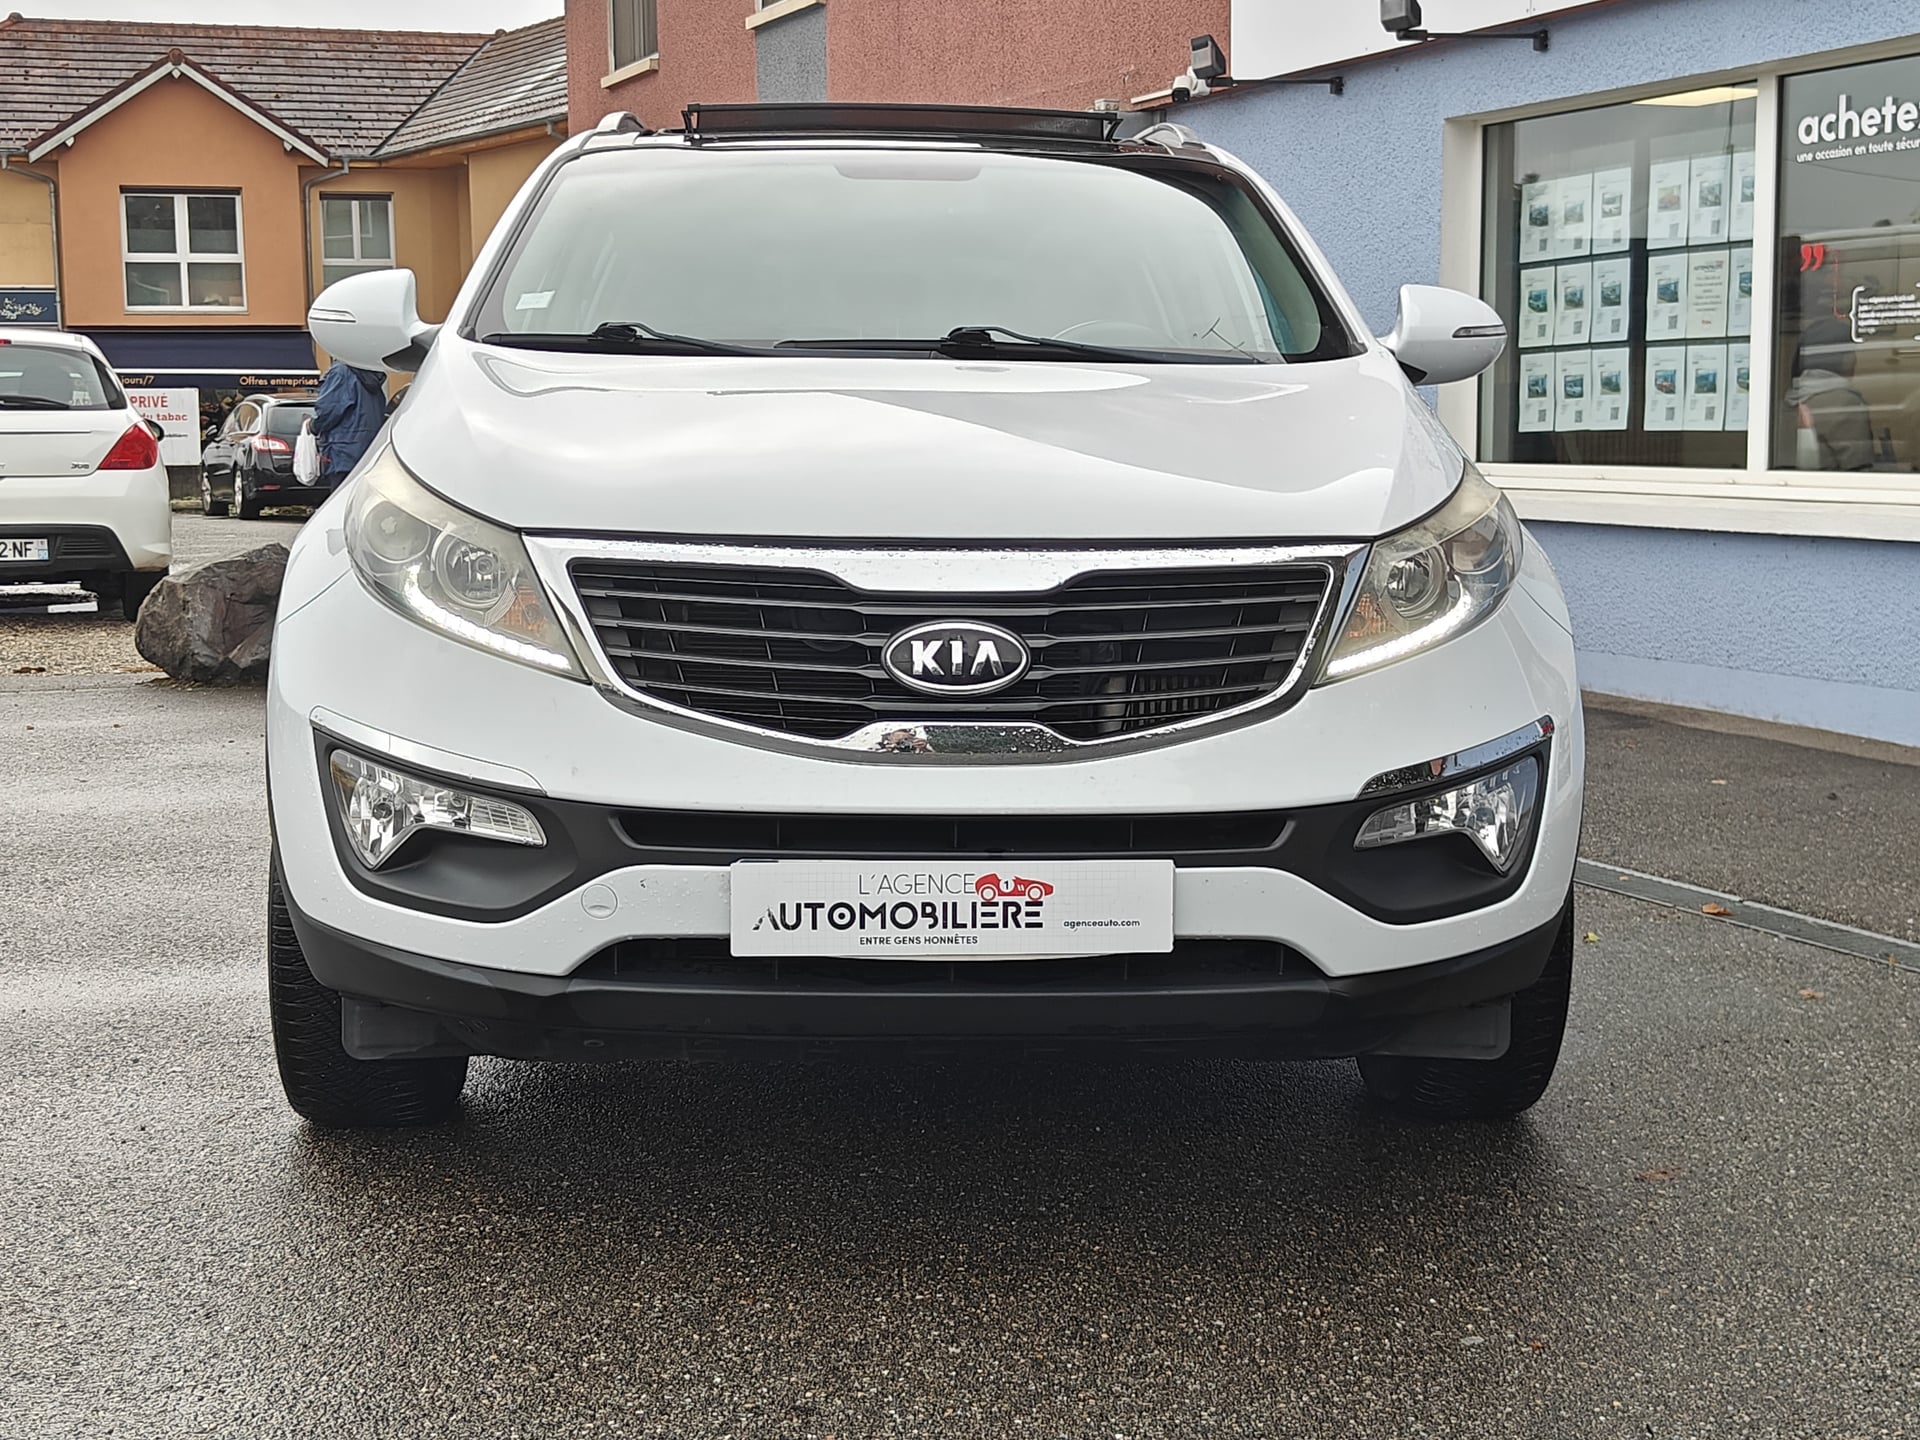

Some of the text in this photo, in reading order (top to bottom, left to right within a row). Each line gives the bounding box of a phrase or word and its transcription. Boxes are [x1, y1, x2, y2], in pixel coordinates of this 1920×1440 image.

[1797, 94, 1920, 145] achete
[1796, 152, 1813, 163] une
[1815, 144, 1853, 160] occasion
[1854, 146, 1867, 156] en
[1868, 140, 1894, 154] toute
[240, 376, 319, 388] Offres entreprises
[156, 412, 188, 421] tabac
[910, 640, 1005, 676] KIA
[859, 873, 976, 895] L'AGENCE
[1063, 919, 1140, 929] agenceauto.com
[859, 932, 979, 945] ENTRE GENS HONNÊTES
